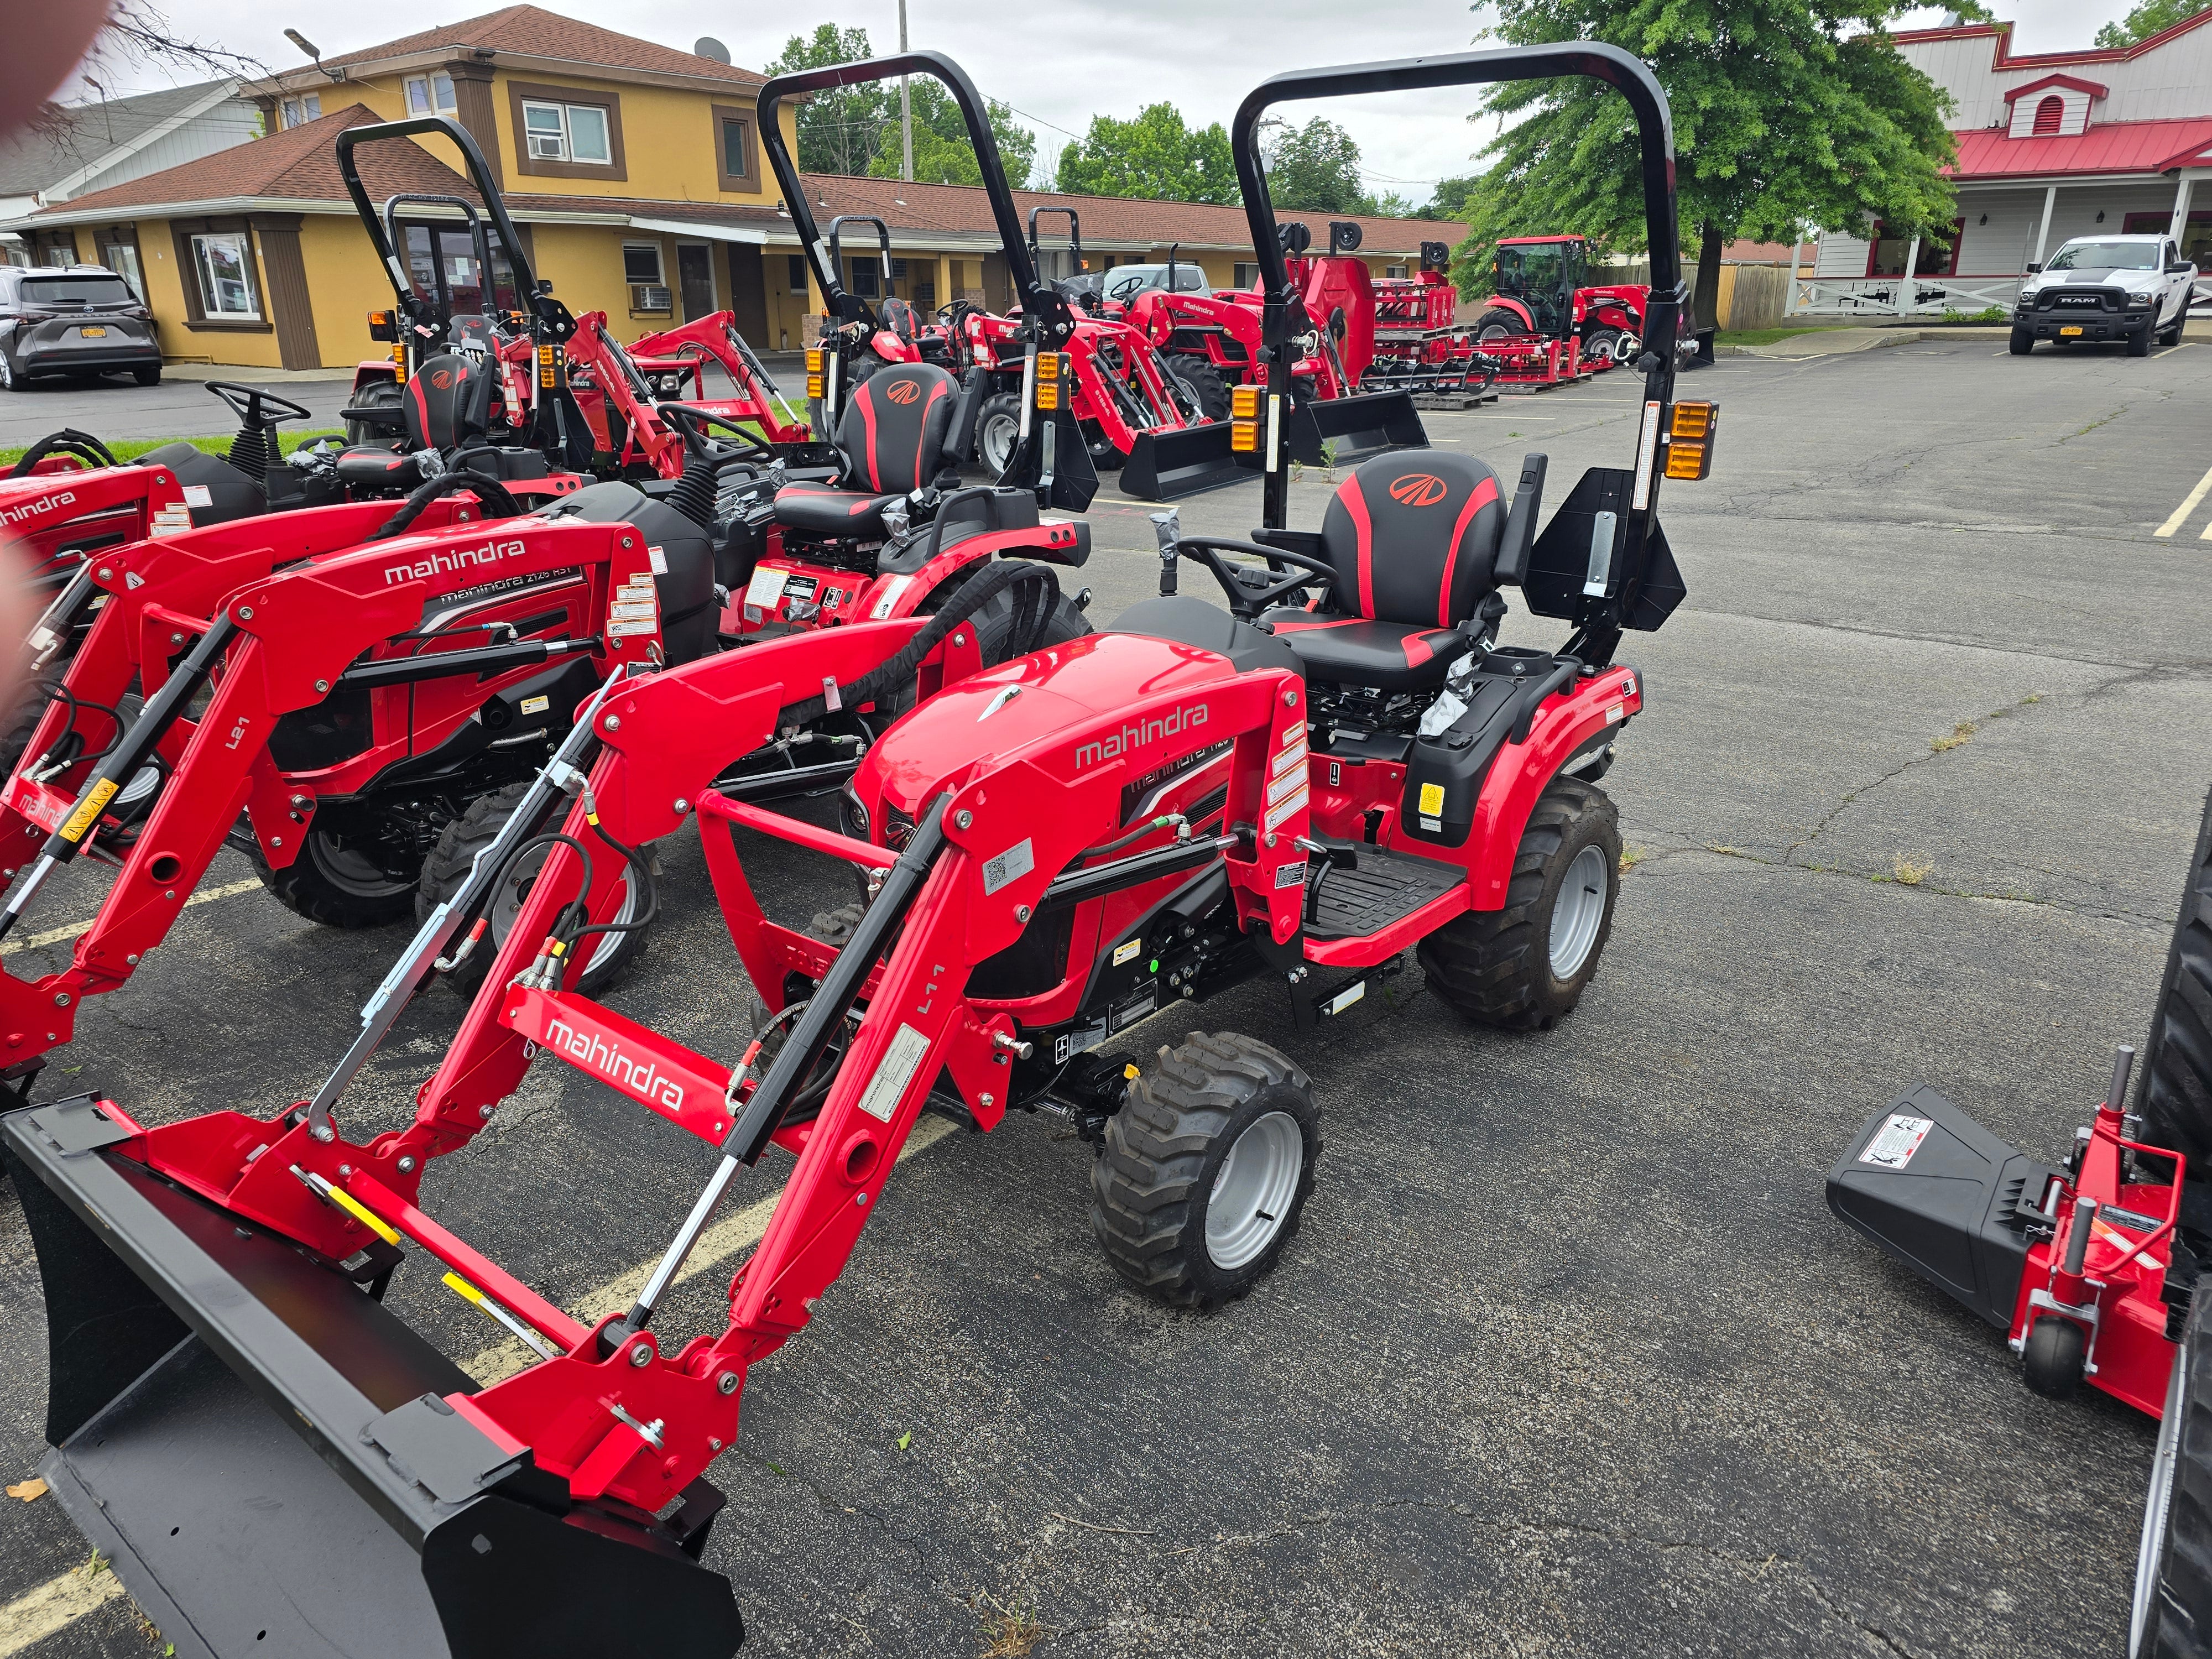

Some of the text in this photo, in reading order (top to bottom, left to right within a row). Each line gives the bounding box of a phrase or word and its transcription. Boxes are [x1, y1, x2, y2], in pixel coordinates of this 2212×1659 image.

[1183, 301, 1214, 316] Mahindra
[384, 540, 525, 585] mahindra
[440, 576, 524, 604] mahindra
[225, 717, 250, 750] L21
[1076, 703, 1208, 769] mahindra
[917, 964, 946, 1014] L11
[546, 1019, 684, 1112] mahindra
[865, 1077, 884, 1108] mahindra
